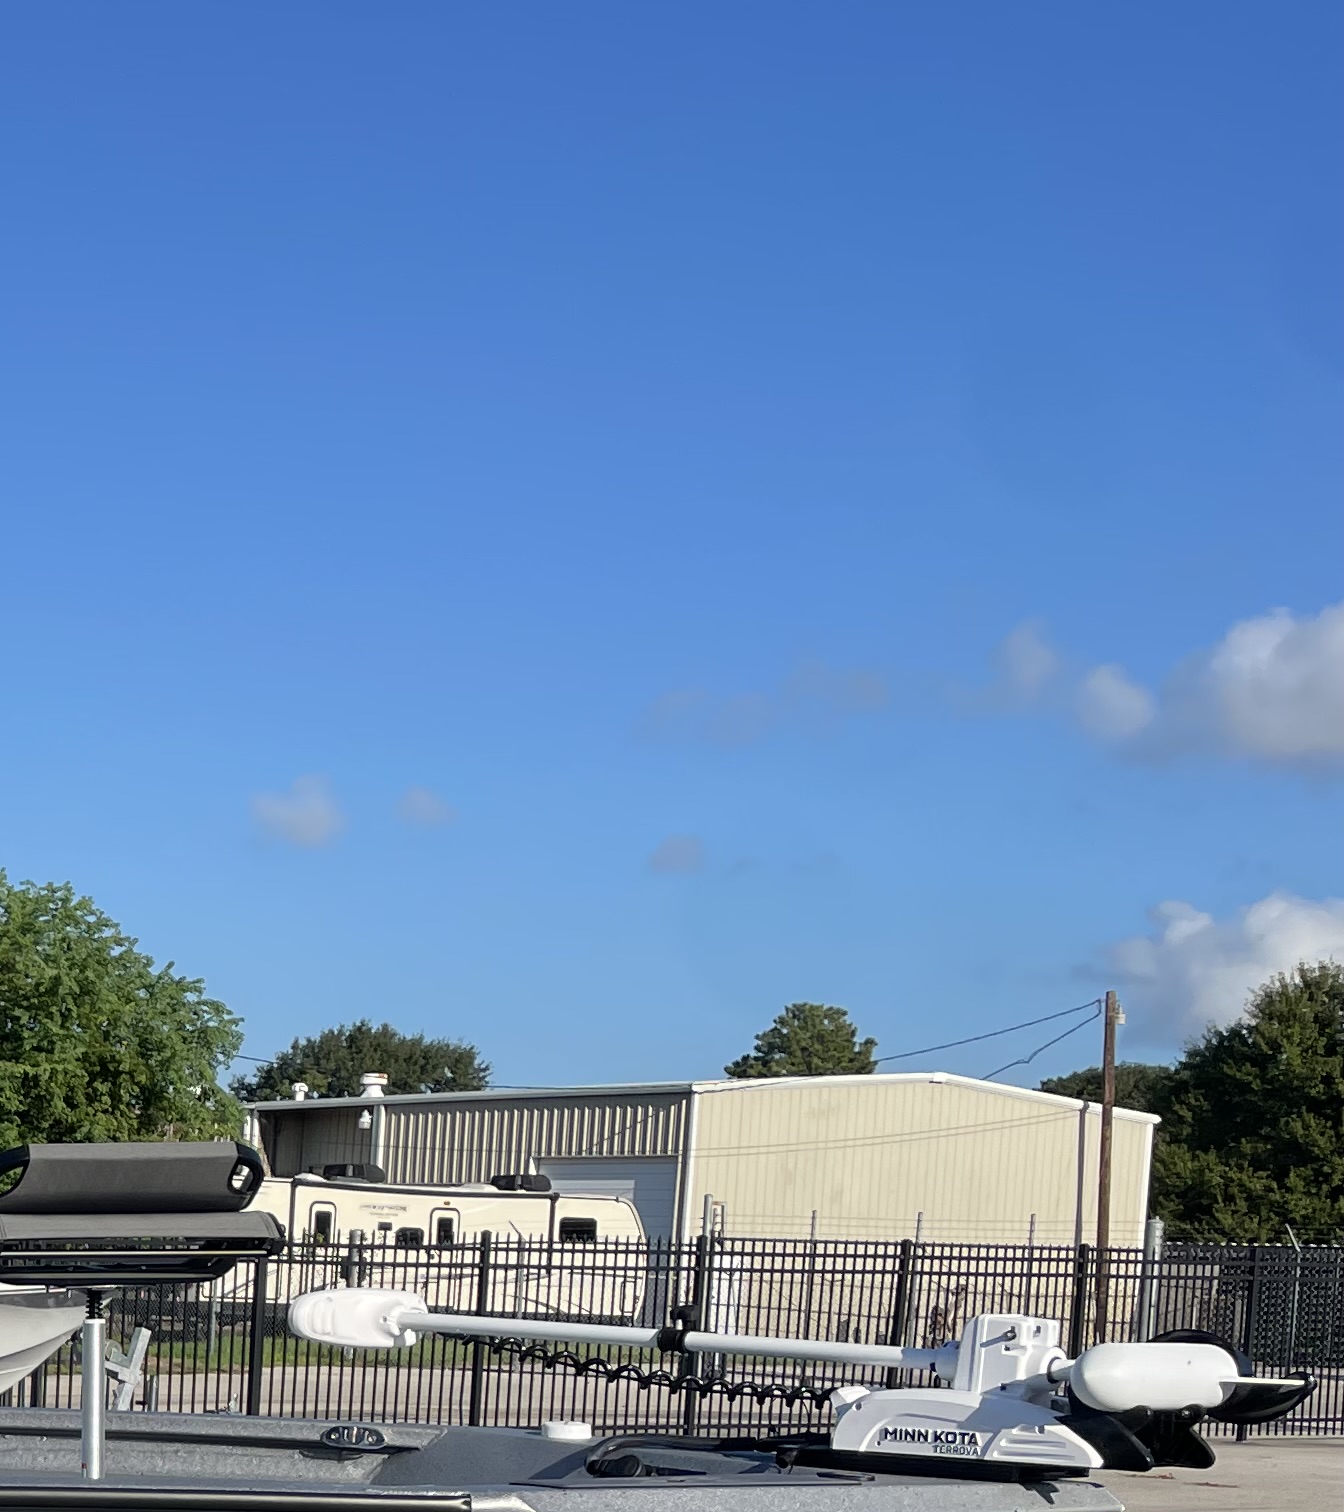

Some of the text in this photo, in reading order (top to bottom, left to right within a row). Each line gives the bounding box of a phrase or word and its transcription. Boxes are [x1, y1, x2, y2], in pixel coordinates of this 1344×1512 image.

[883, 1427, 979, 1446] MINN KOTA
[932, 1444, 980, 1456] TERROVA
